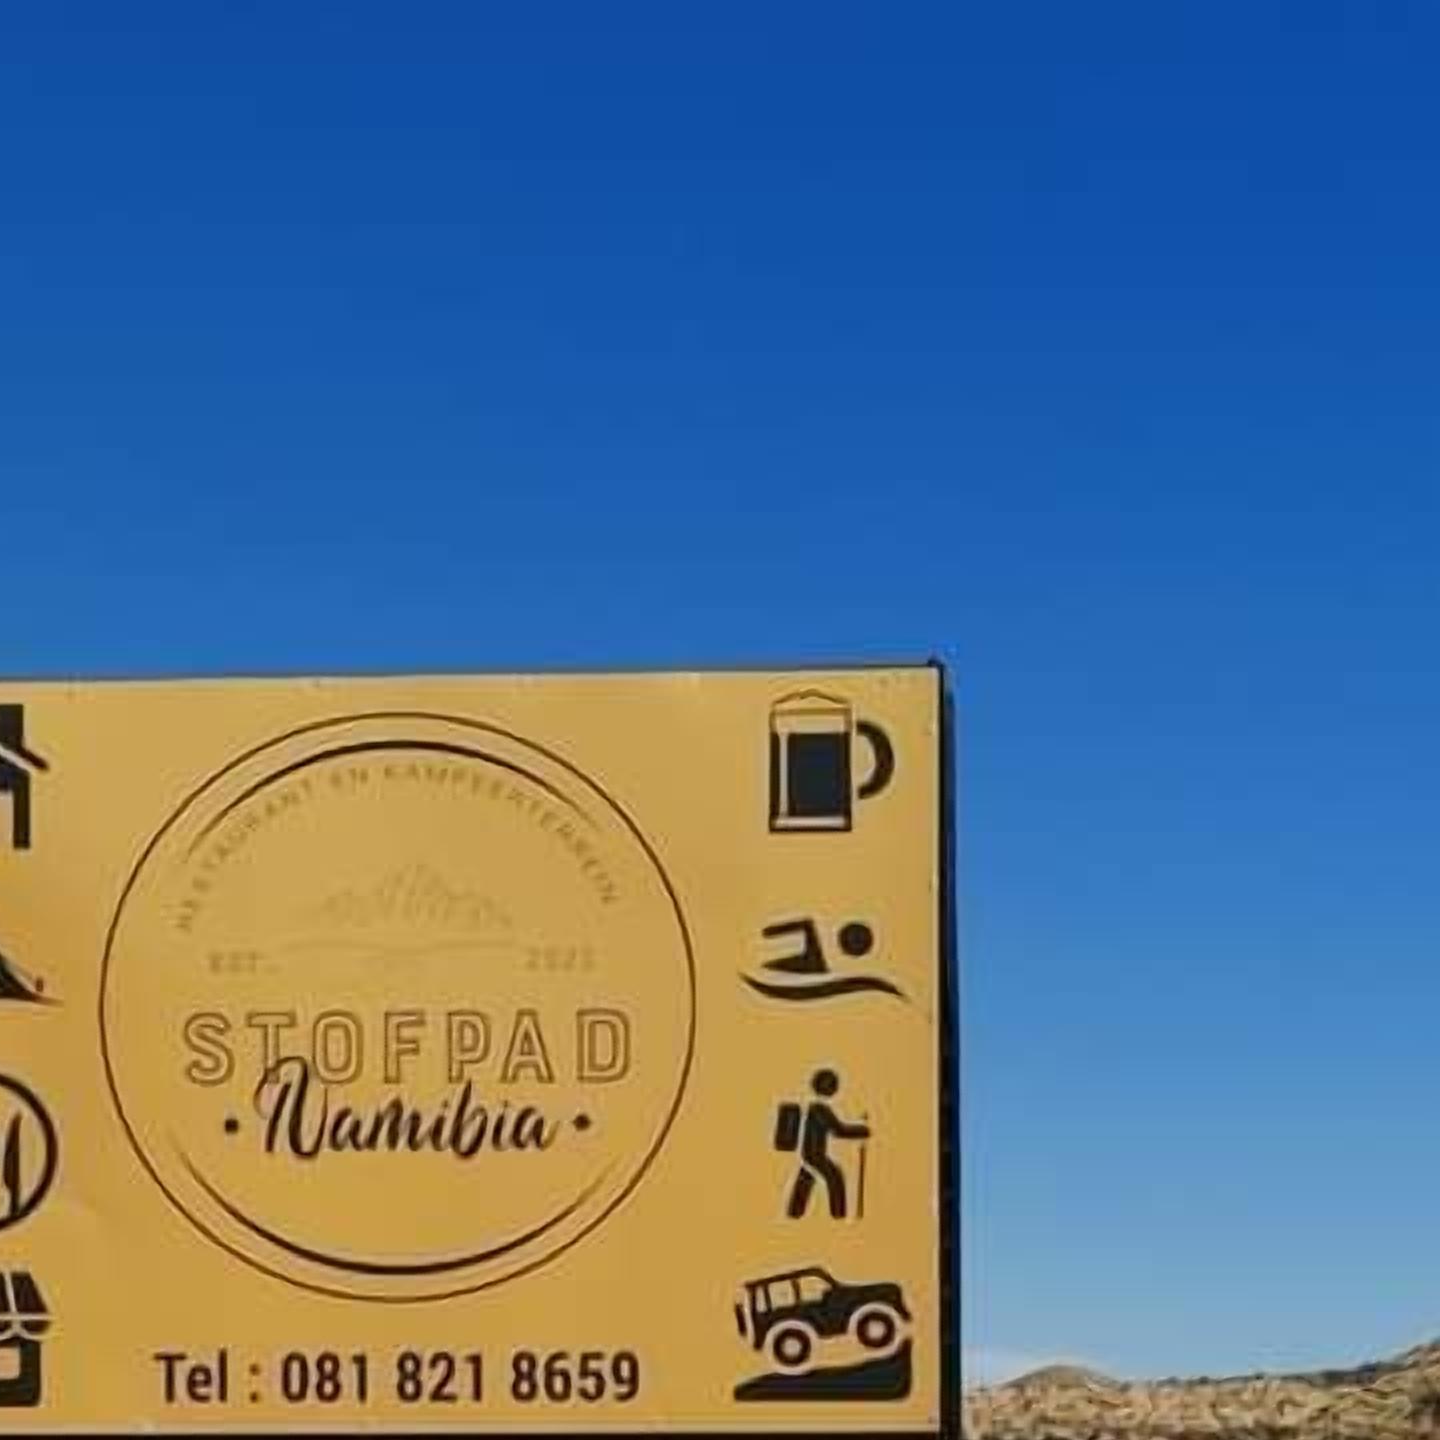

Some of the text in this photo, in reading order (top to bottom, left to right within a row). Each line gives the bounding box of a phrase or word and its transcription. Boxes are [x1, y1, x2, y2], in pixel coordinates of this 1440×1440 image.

[182, 1008, 632, 1087] STOFPAD
[252, 1056, 560, 1160] Namibia
[153, 1350, 228, 1404] Tel
[280, 1351, 369, 1403] 081
[396, 1351, 484, 1403] 821
[510, 1351, 641, 1403] 8659
